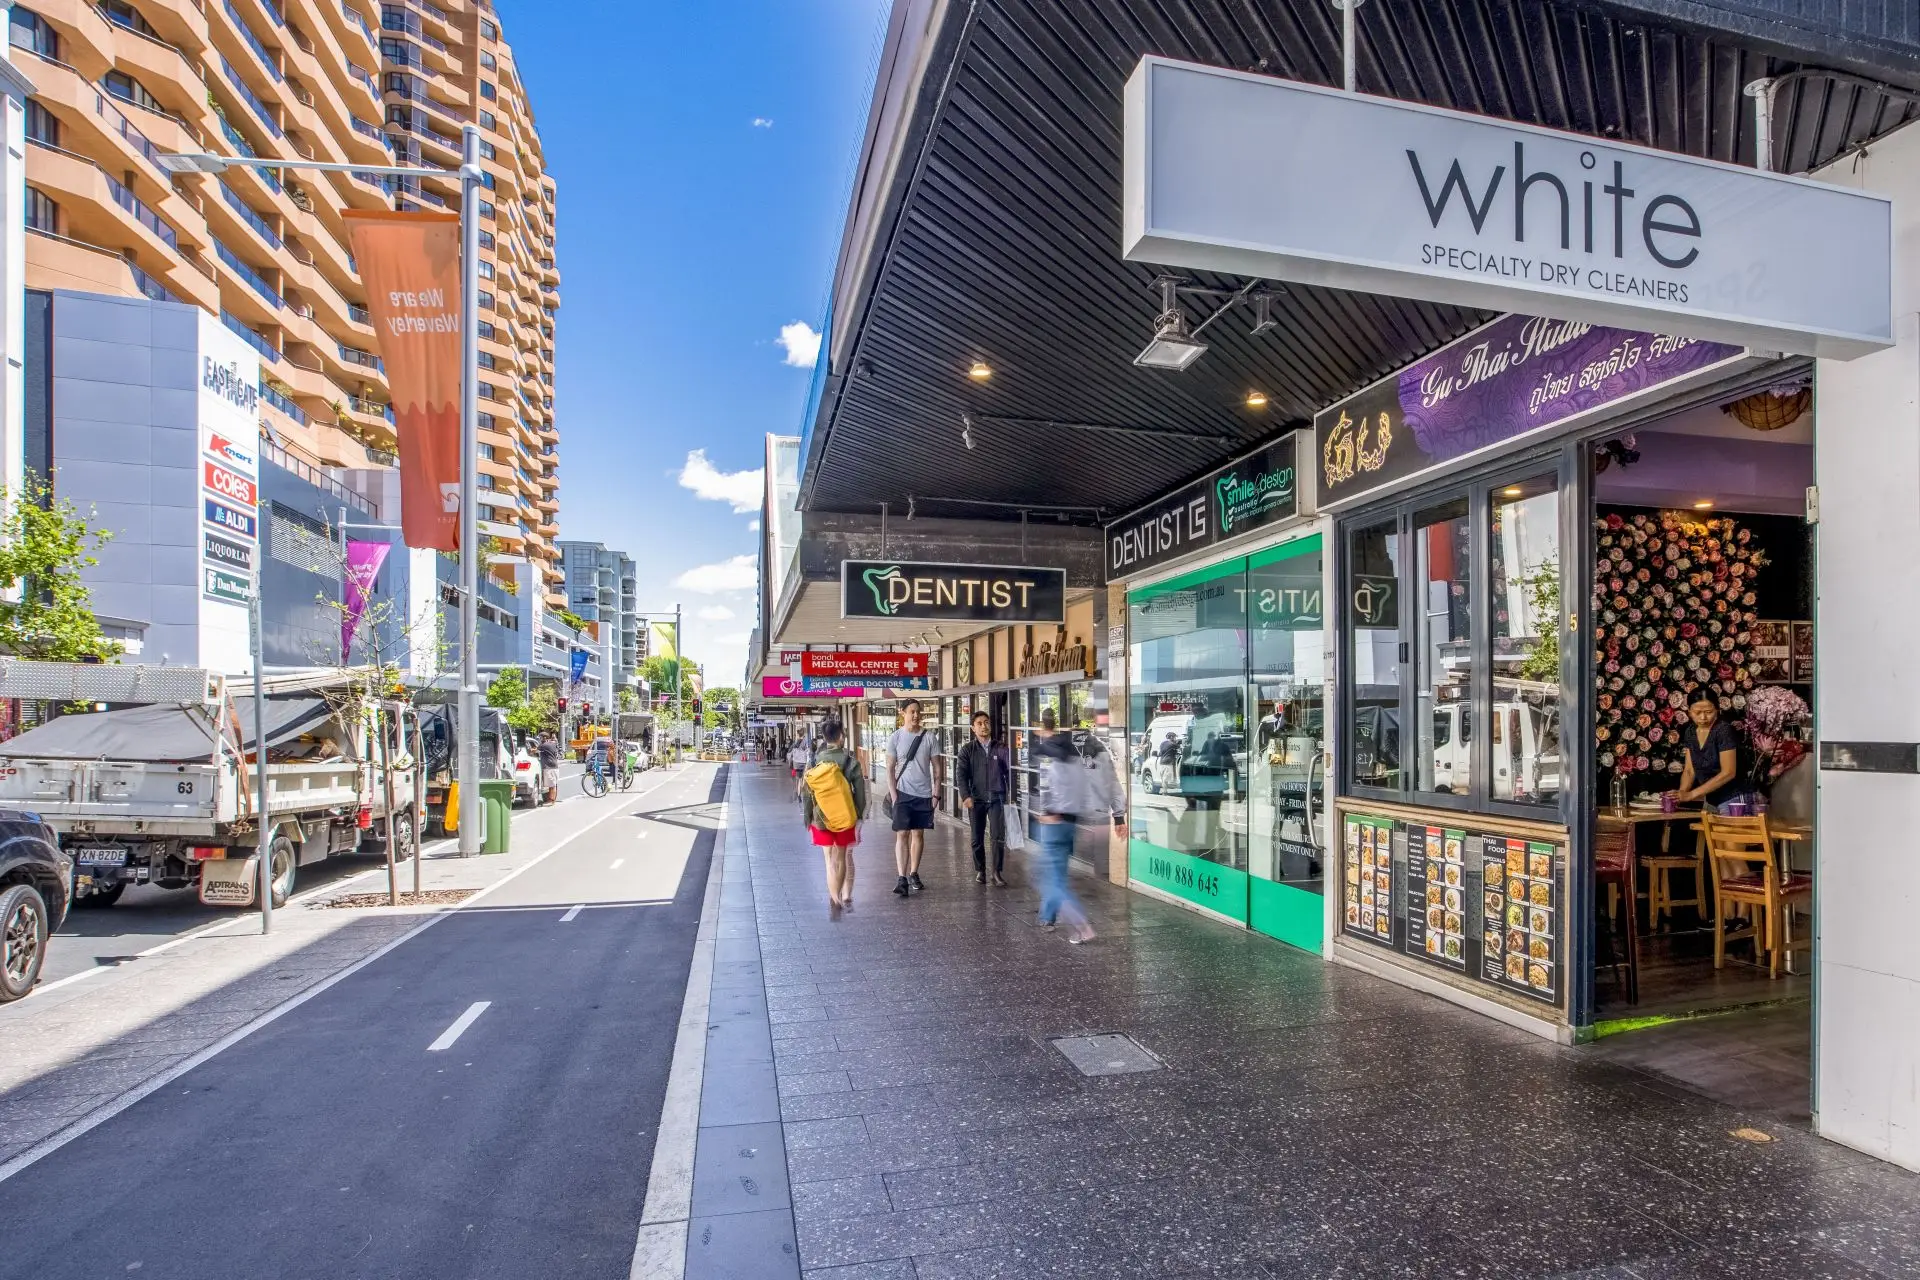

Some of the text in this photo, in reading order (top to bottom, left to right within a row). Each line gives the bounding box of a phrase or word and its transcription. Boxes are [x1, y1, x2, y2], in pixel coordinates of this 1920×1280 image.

[1406, 141, 1701, 268] white
[1422, 244, 1532, 279] SPECIALTY
[1540, 262, 1580, 286] DRY
[1588, 270, 1689, 303] CLEANERS
[1420, 366, 1454, 408] Gu
[1456, 340, 1511, 391] Thai
[210, 433, 253, 465] Kmart
[213, 468, 249, 502] coles
[1228, 480, 1254, 506] smile
[1260, 467, 1293, 492] design
[225, 510, 249, 533] ALDI
[1113, 506, 1184, 570] DENTIST
[889, 577, 1035, 608] DENTIST
[1569, 614, 1578, 631] 5
[812, 653, 834, 661] bondi
[812, 661, 899, 669] MEDICAL CENTRE
[810, 681, 831, 690] SKIN
[177, 781, 193, 794] 63
[1288, 782, 1307, 792] HOURS
[1301, 846, 1316, 858] ONLY
[1482, 837, 1505, 854] THAI FOOD
[204, 881, 250, 895] ADTRANS
[1148, 856, 1219, 897] 1800 888 645
